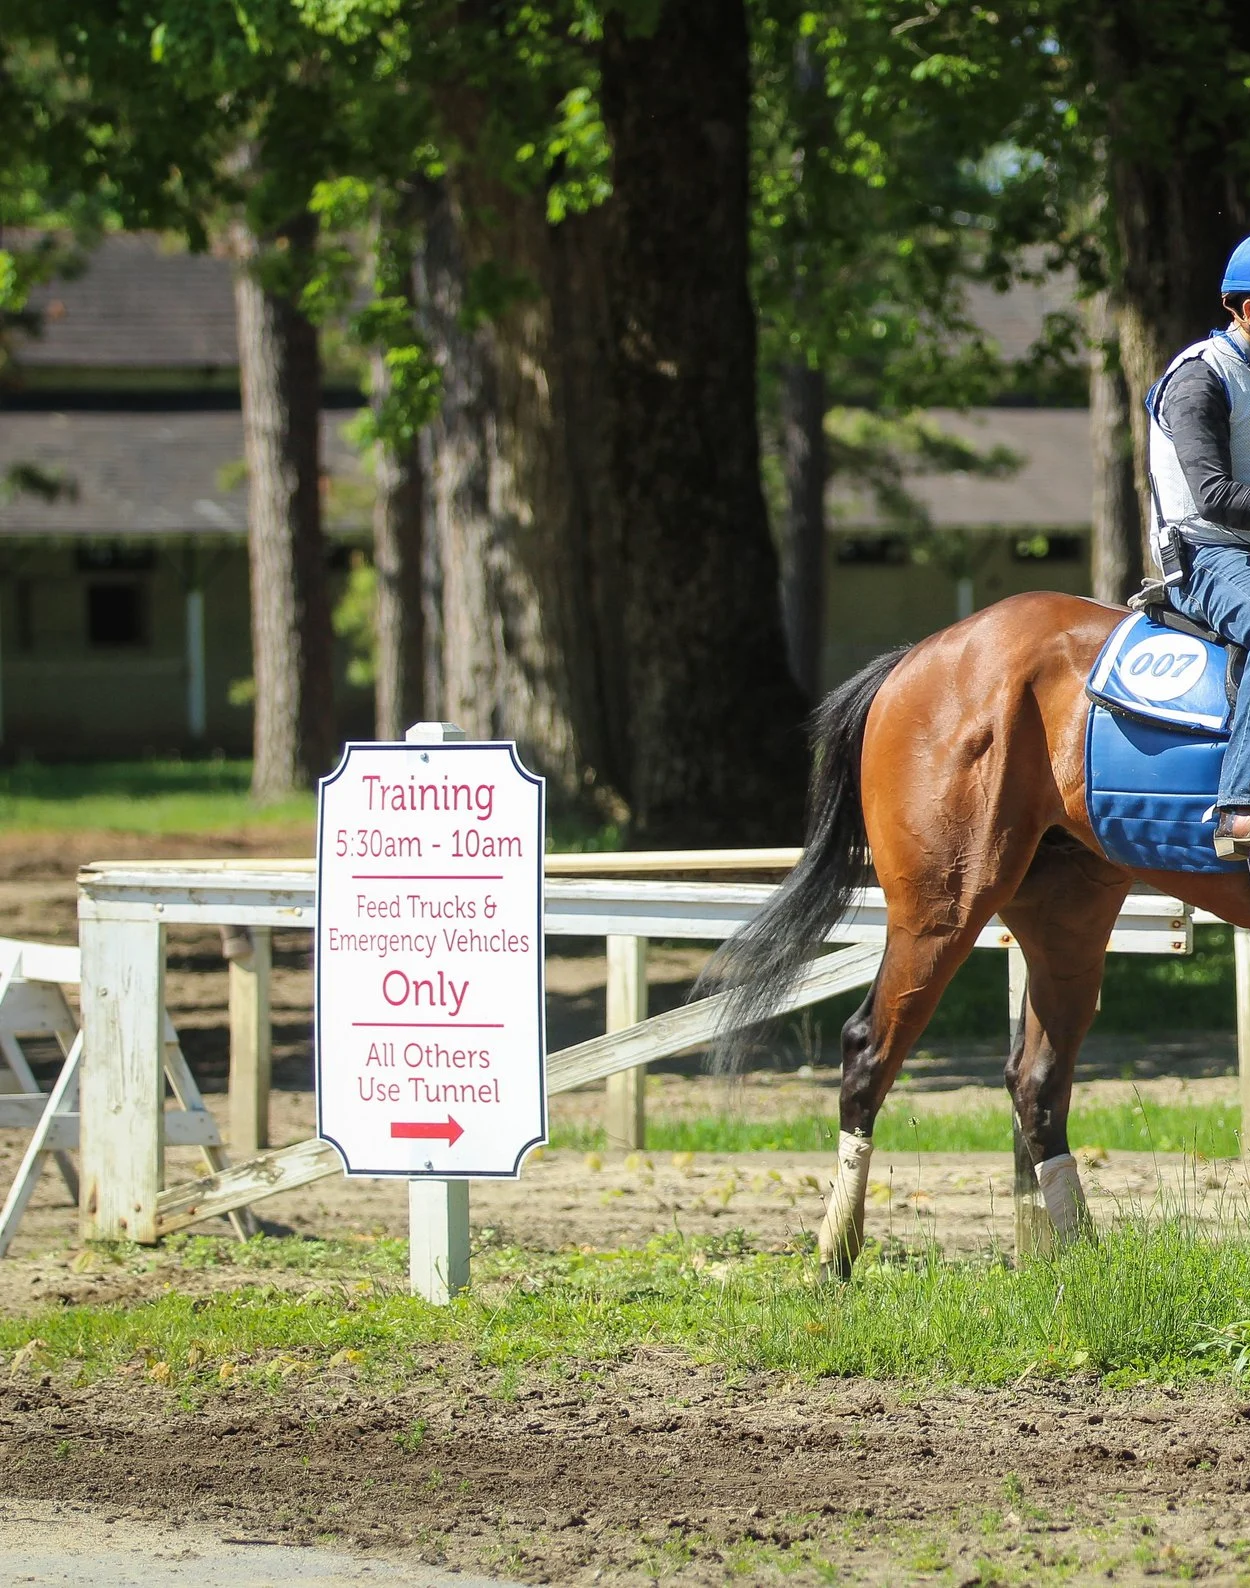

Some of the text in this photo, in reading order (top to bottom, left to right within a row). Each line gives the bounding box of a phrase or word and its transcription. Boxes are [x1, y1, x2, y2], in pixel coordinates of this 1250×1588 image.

[1130, 652, 1199, 678] 007
[362, 775, 495, 821] Training
[335, 829, 422, 858] 5:30am
[451, 829, 523, 858] 10am
[357, 895, 497, 919] Feed Trucks &
[329, 928, 530, 958] Emergency Vehicles
[382, 969, 469, 1016] Only
[366, 1042, 490, 1069] All Others
[357, 1077, 500, 1103] Use Tunnel
